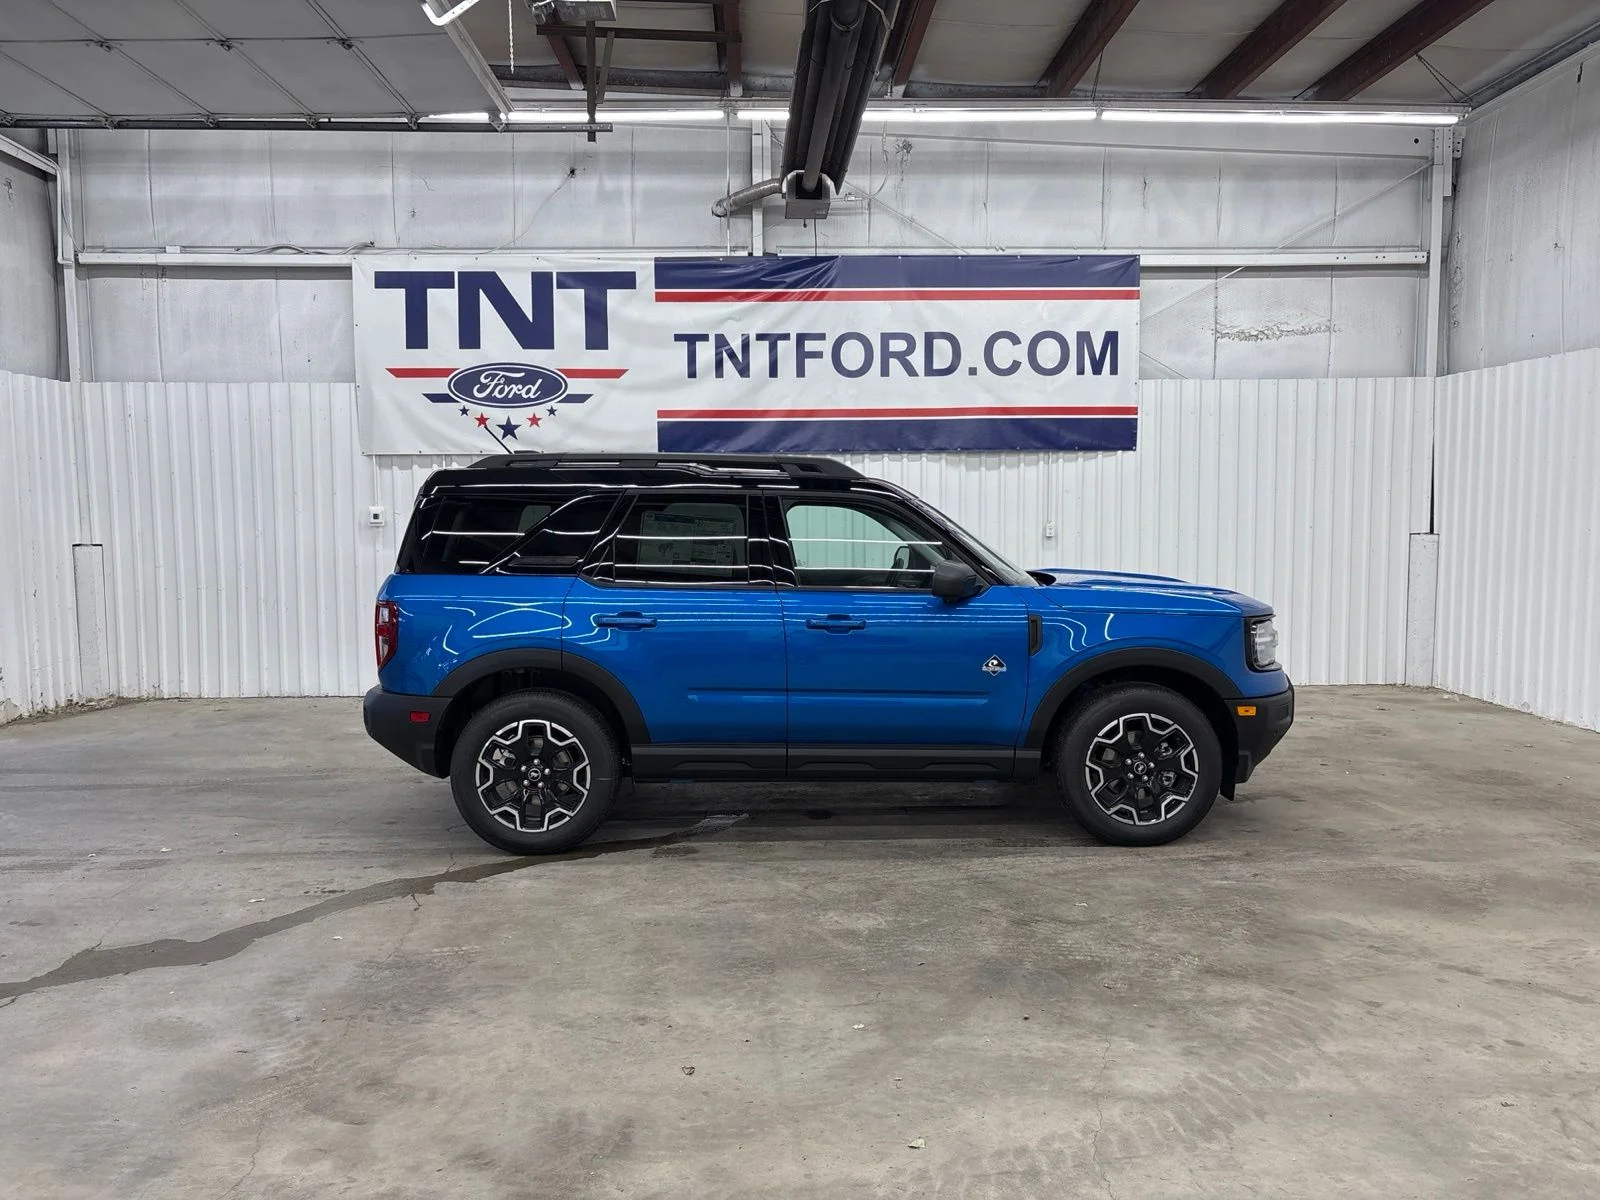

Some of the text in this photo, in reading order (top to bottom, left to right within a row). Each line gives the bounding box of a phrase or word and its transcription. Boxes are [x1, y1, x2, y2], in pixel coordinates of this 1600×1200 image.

[374, 271, 636, 350] TNT
[673, 330, 1119, 378] TNTFORD.COM
[472, 369, 542, 400] Ford
